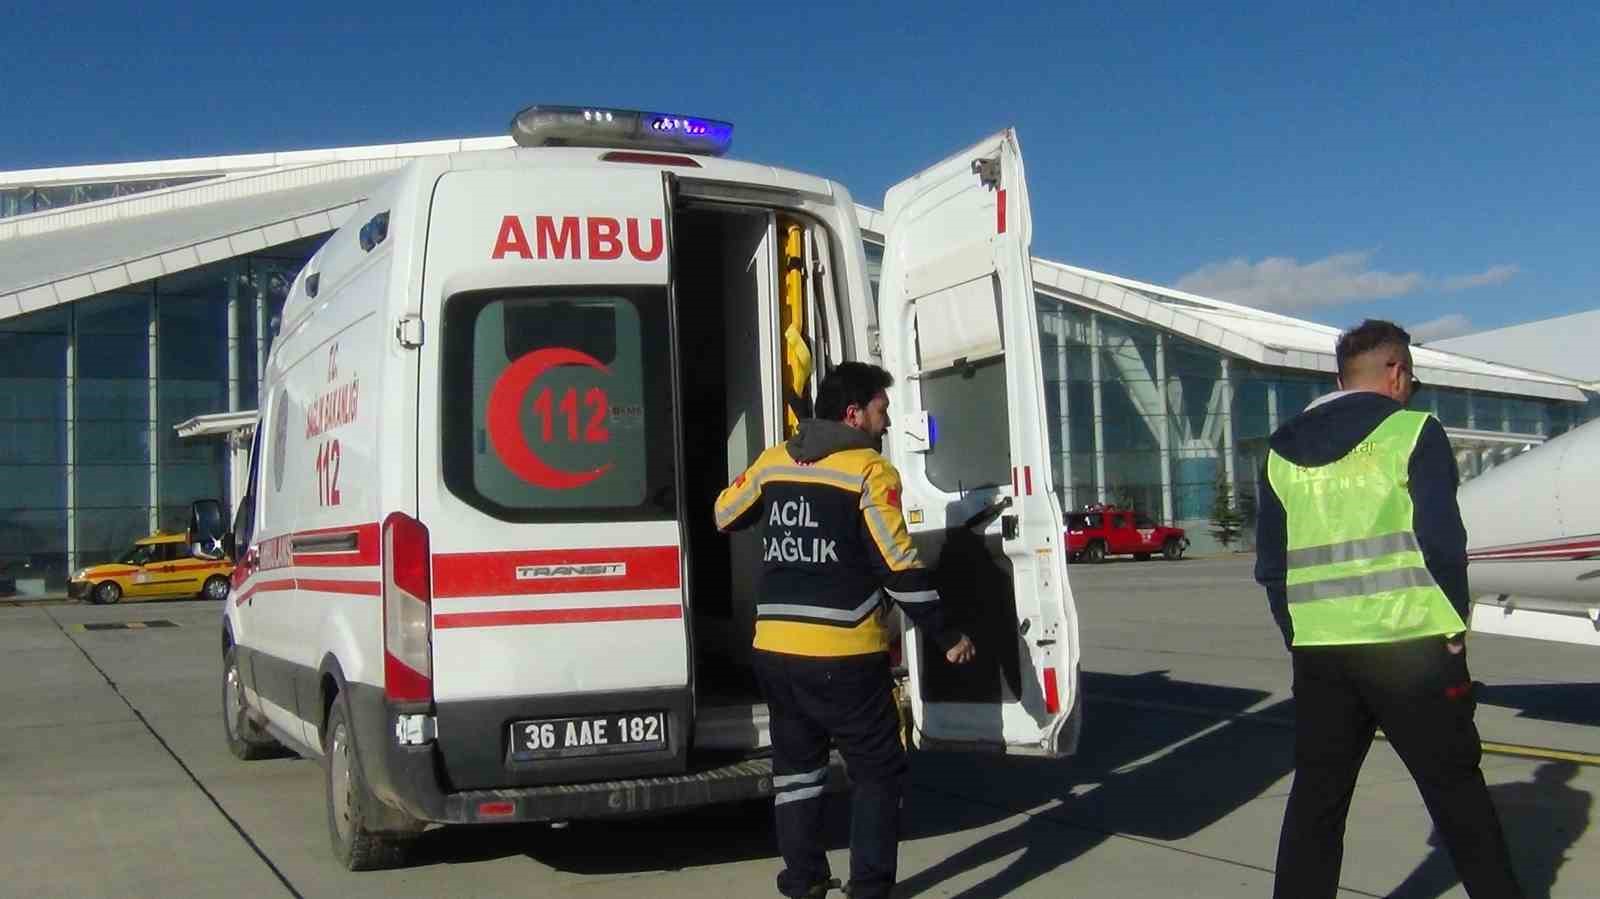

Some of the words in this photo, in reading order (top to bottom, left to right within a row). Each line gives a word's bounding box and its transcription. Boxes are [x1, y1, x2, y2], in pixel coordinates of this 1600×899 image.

[491, 215, 664, 262] AMBU
[533, 387, 610, 444] 112
[316, 439, 341, 507] 112
[769, 496, 819, 528] ACİL
[517, 563, 625, 578] TRANSIT
[525, 724, 555, 749] 36
[564, 719, 608, 746] AAE
[617, 716, 659, 742] 182
